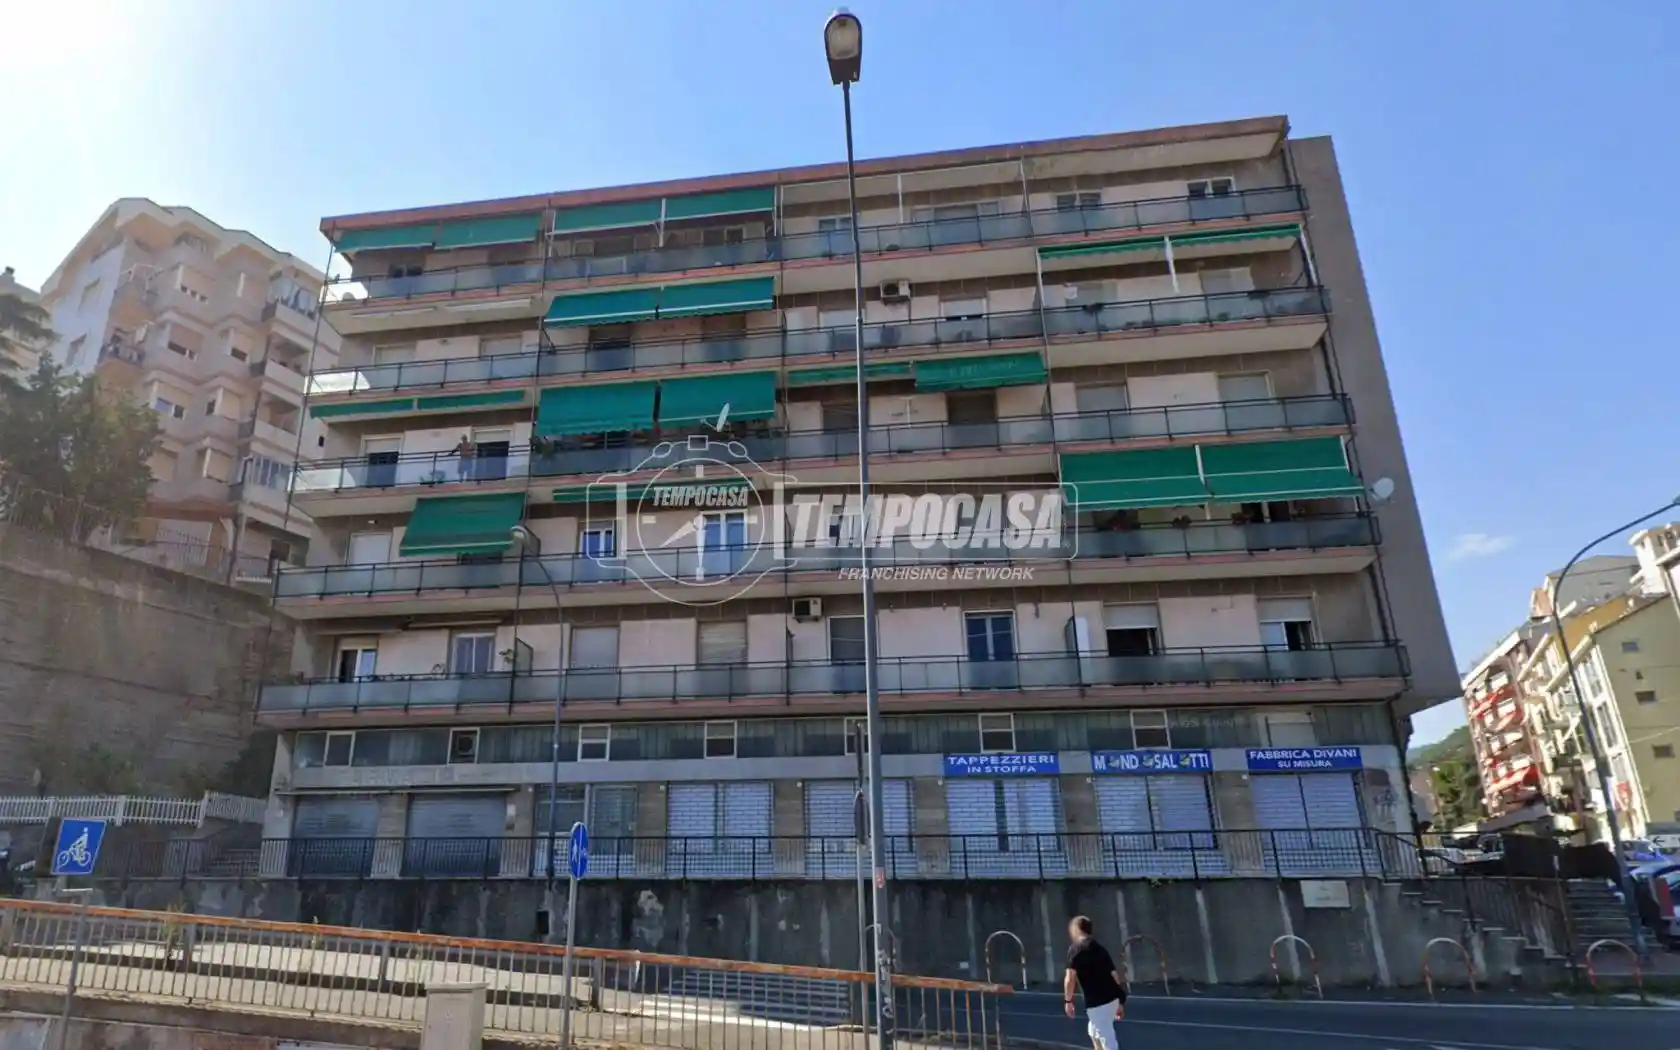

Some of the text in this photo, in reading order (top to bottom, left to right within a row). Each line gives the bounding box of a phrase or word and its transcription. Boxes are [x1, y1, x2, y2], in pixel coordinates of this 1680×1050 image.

[1249, 748, 1357, 760] FABBRICA DIVANI
[947, 754, 1055, 765] TAPPEZZIERI
[1277, 759, 1333, 769] SU MISURA
[967, 764, 1037, 774] IN STOFFA
